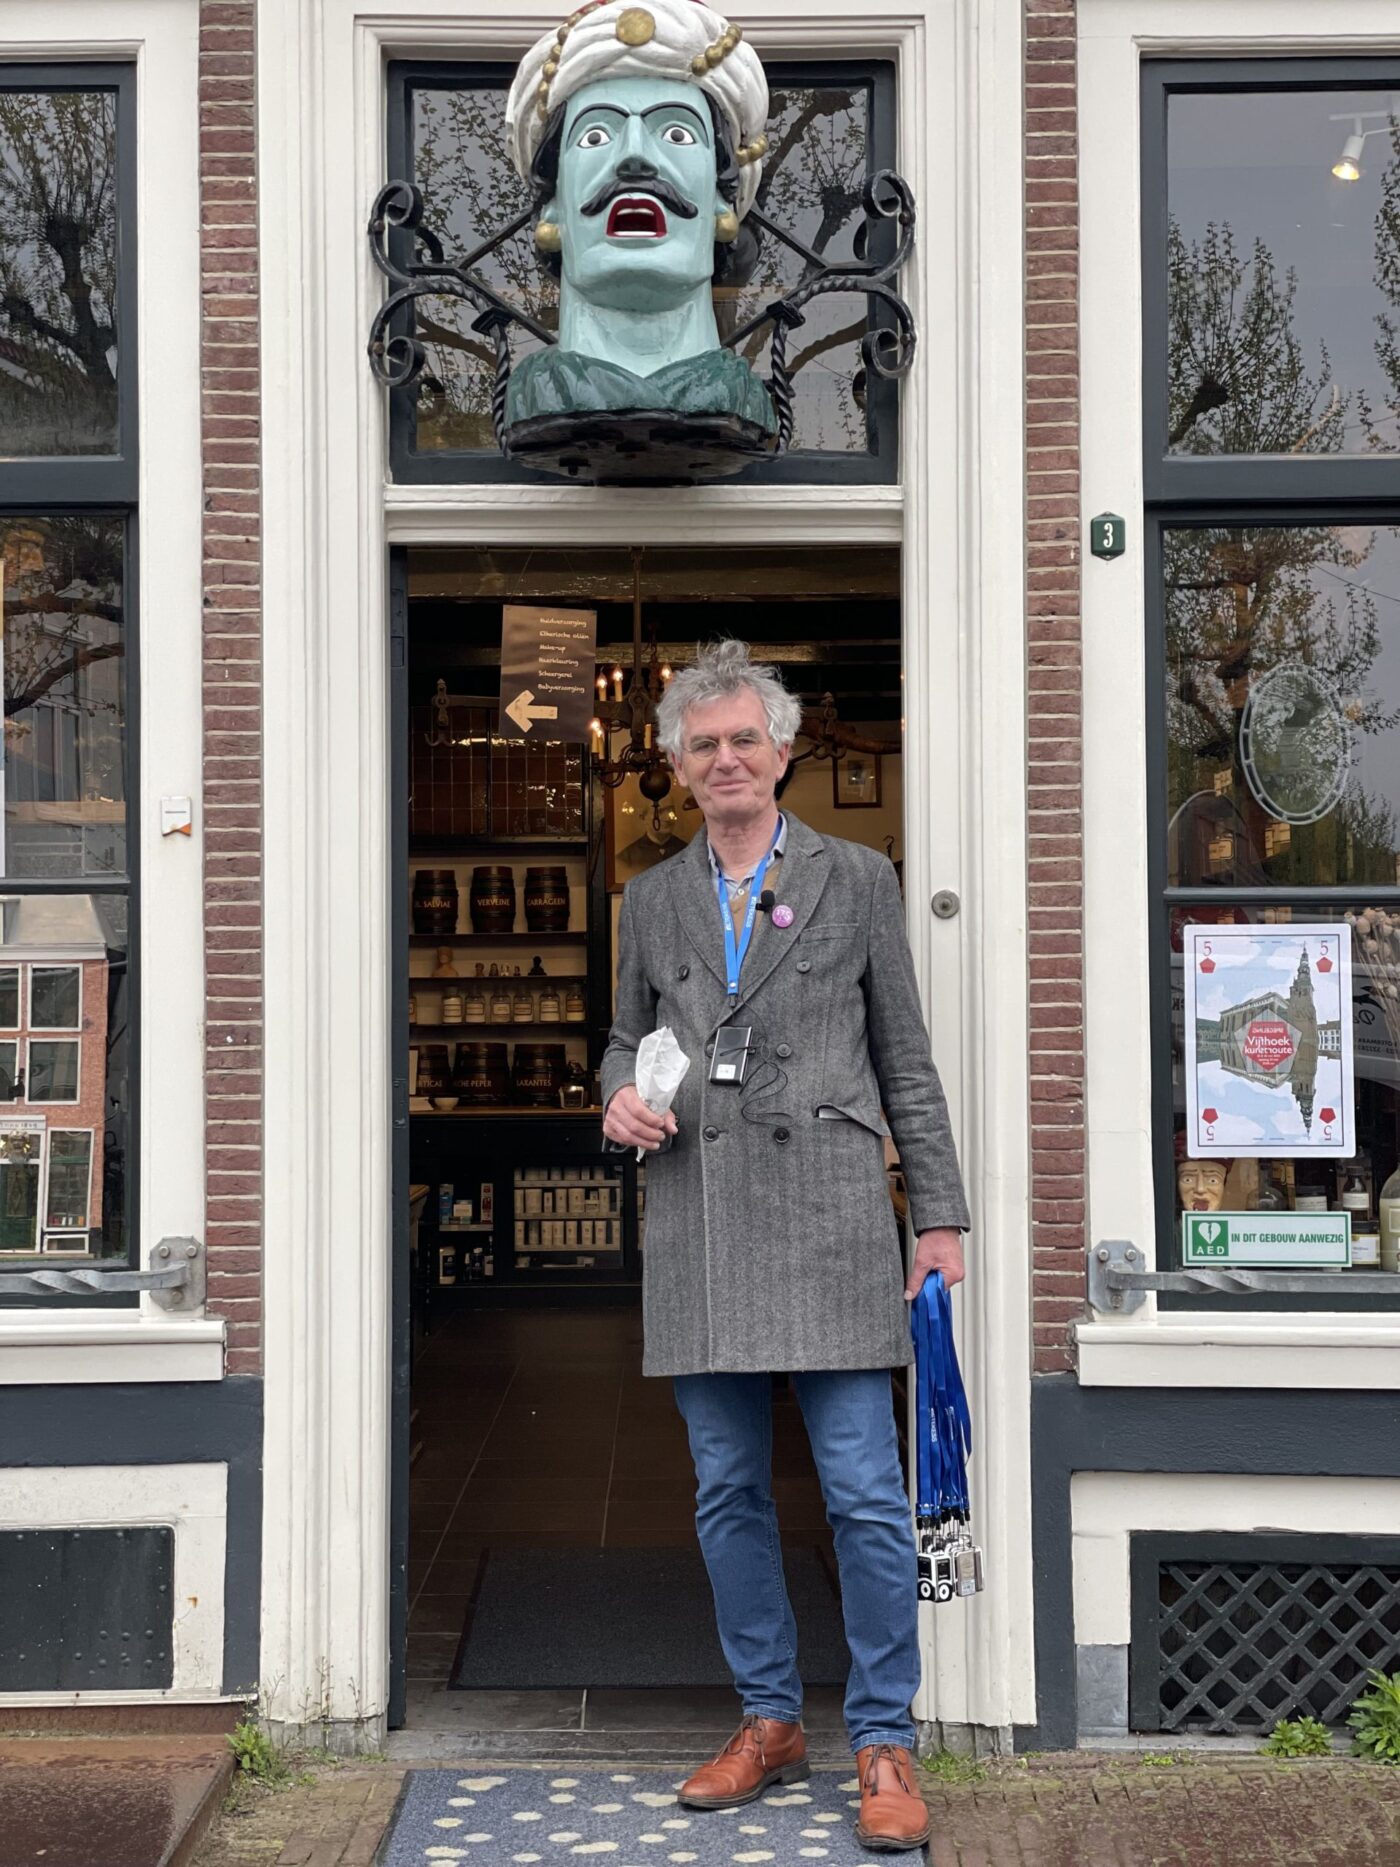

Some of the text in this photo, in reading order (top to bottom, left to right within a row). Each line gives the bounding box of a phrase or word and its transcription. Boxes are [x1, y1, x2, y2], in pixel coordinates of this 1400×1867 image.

[1103, 522, 1113, 548] 3
[1202, 941, 1212, 957] 5
[1320, 940, 1329, 956] 5
[1247, 1035, 1290, 1047] Vijfhoek
[1231, 1233, 1344, 1243] IN DIT GEBOUW AANWEZIG
[1196, 1246, 1225, 1255] AED
